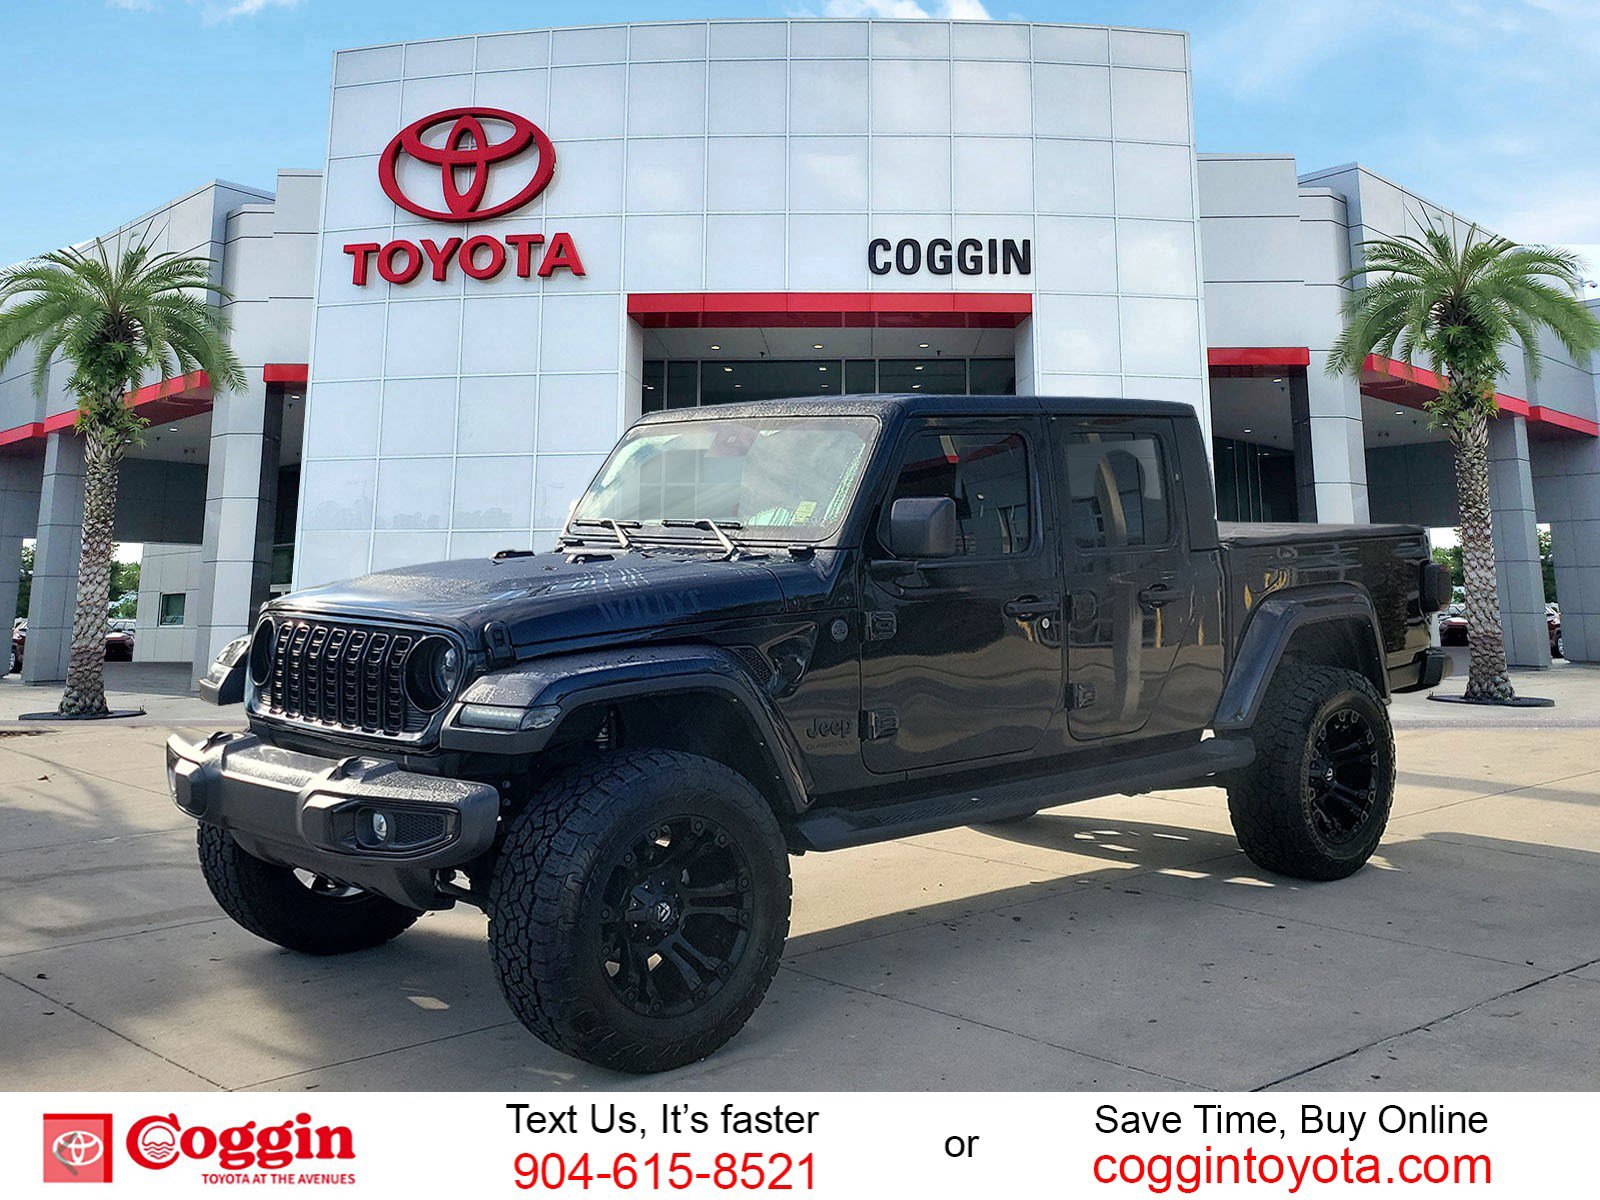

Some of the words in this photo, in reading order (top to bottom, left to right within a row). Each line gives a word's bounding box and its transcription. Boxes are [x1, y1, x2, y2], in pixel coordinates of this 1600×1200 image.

[344, 232, 585, 286] TOYOTA
[868, 238, 1031, 275] COGGIN
[806, 718, 851, 739] Jeep
